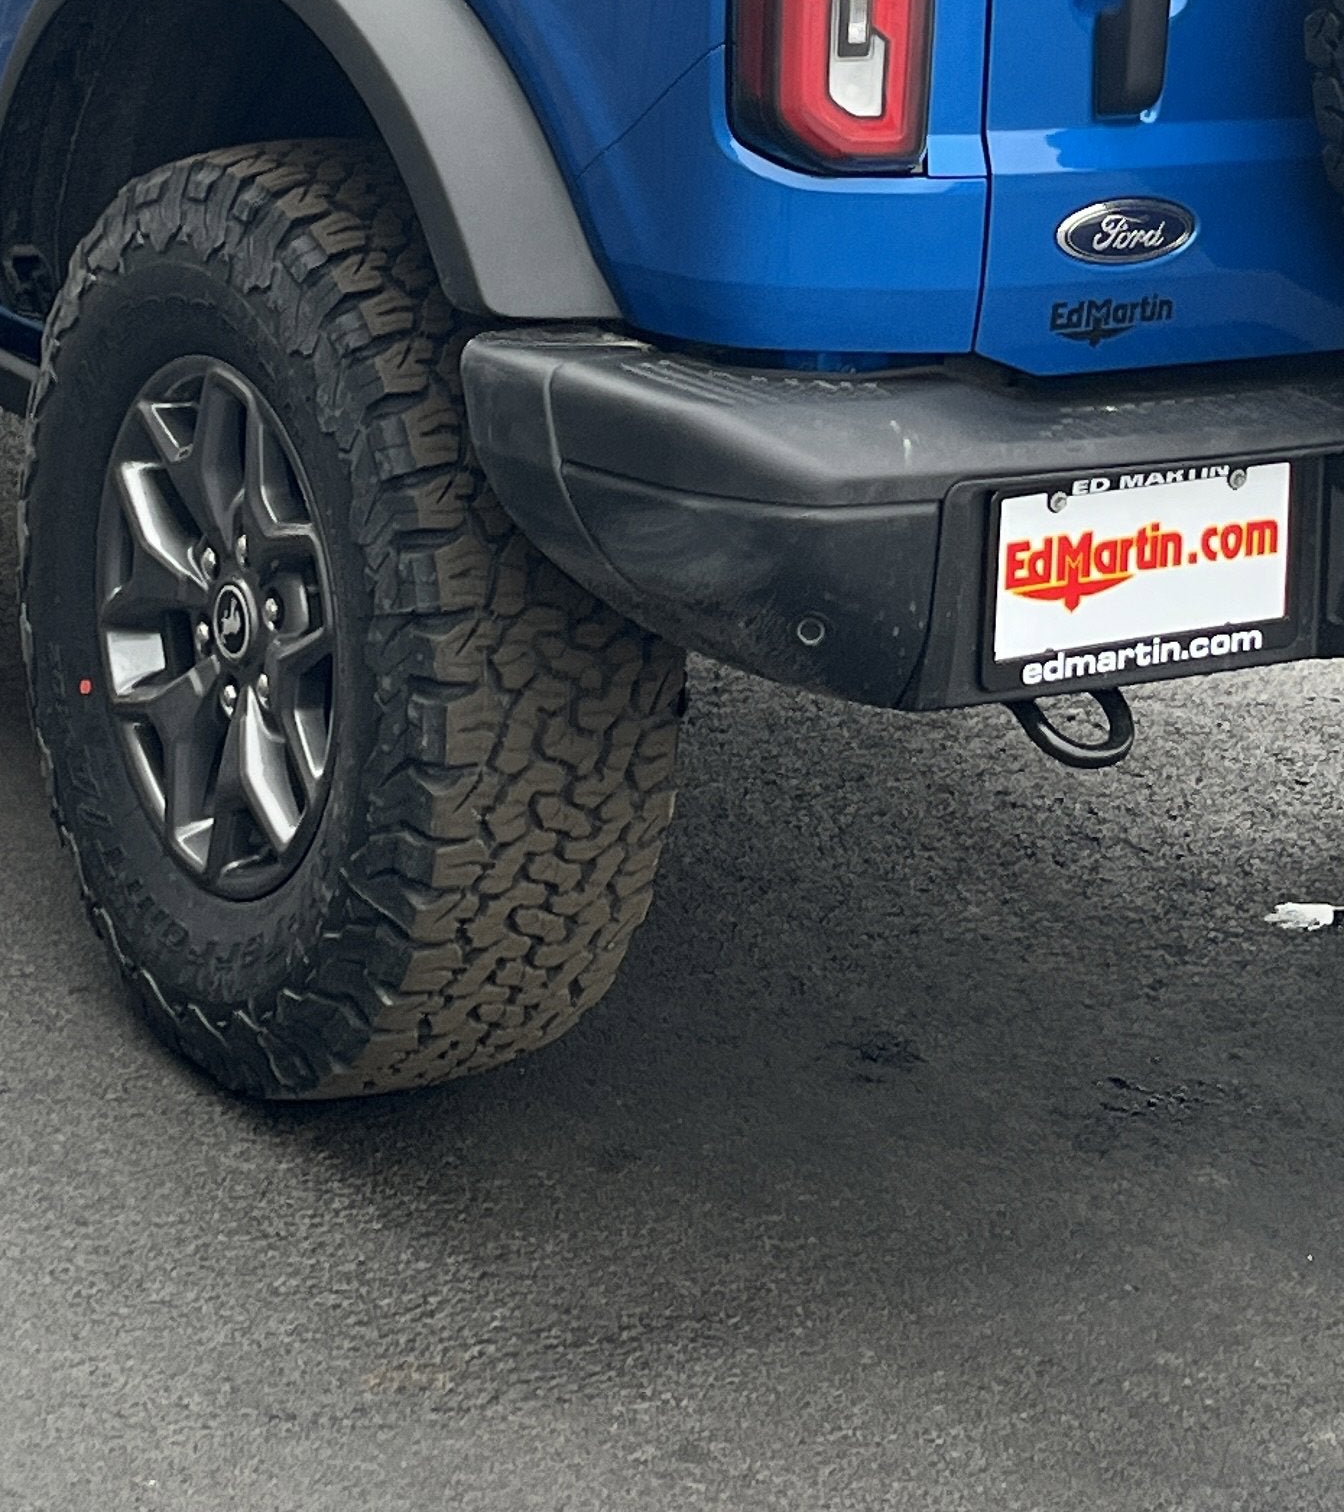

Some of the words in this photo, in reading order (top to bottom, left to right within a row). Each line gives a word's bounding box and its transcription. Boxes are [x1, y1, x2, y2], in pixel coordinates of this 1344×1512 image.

[1092, 214, 1166, 252] Ford
[1049, 292, 1174, 334] EdMartin
[1071, 477, 1111, 496] ED
[1005, 518, 1279, 591] EdMartin.com
[1022, 628, 1264, 686] edmartin.com
